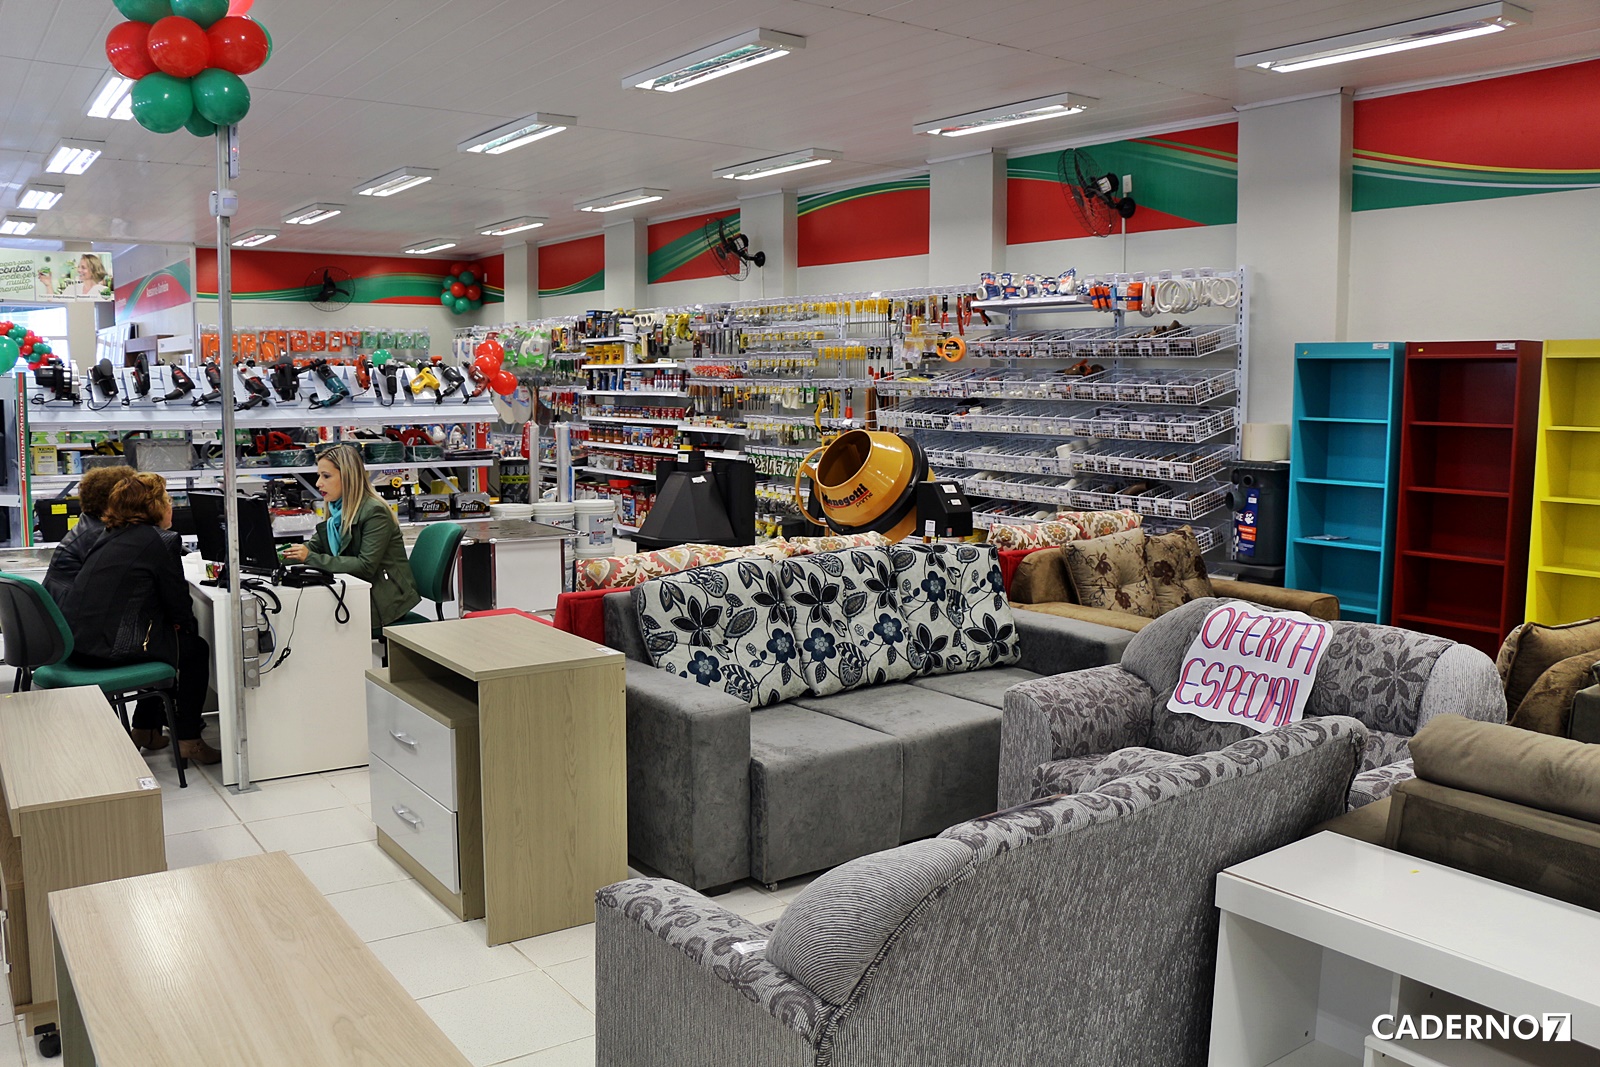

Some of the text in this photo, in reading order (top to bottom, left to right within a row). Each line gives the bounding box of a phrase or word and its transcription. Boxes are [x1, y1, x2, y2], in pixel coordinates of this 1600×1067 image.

[0, 265, 32, 274] contas
[422, 502, 440, 511] Zetta
[461, 502, 479, 512] Zetta
[1201, 606, 1327, 675] OFERTA
[1174, 657, 1300, 727] ESPECIAL
